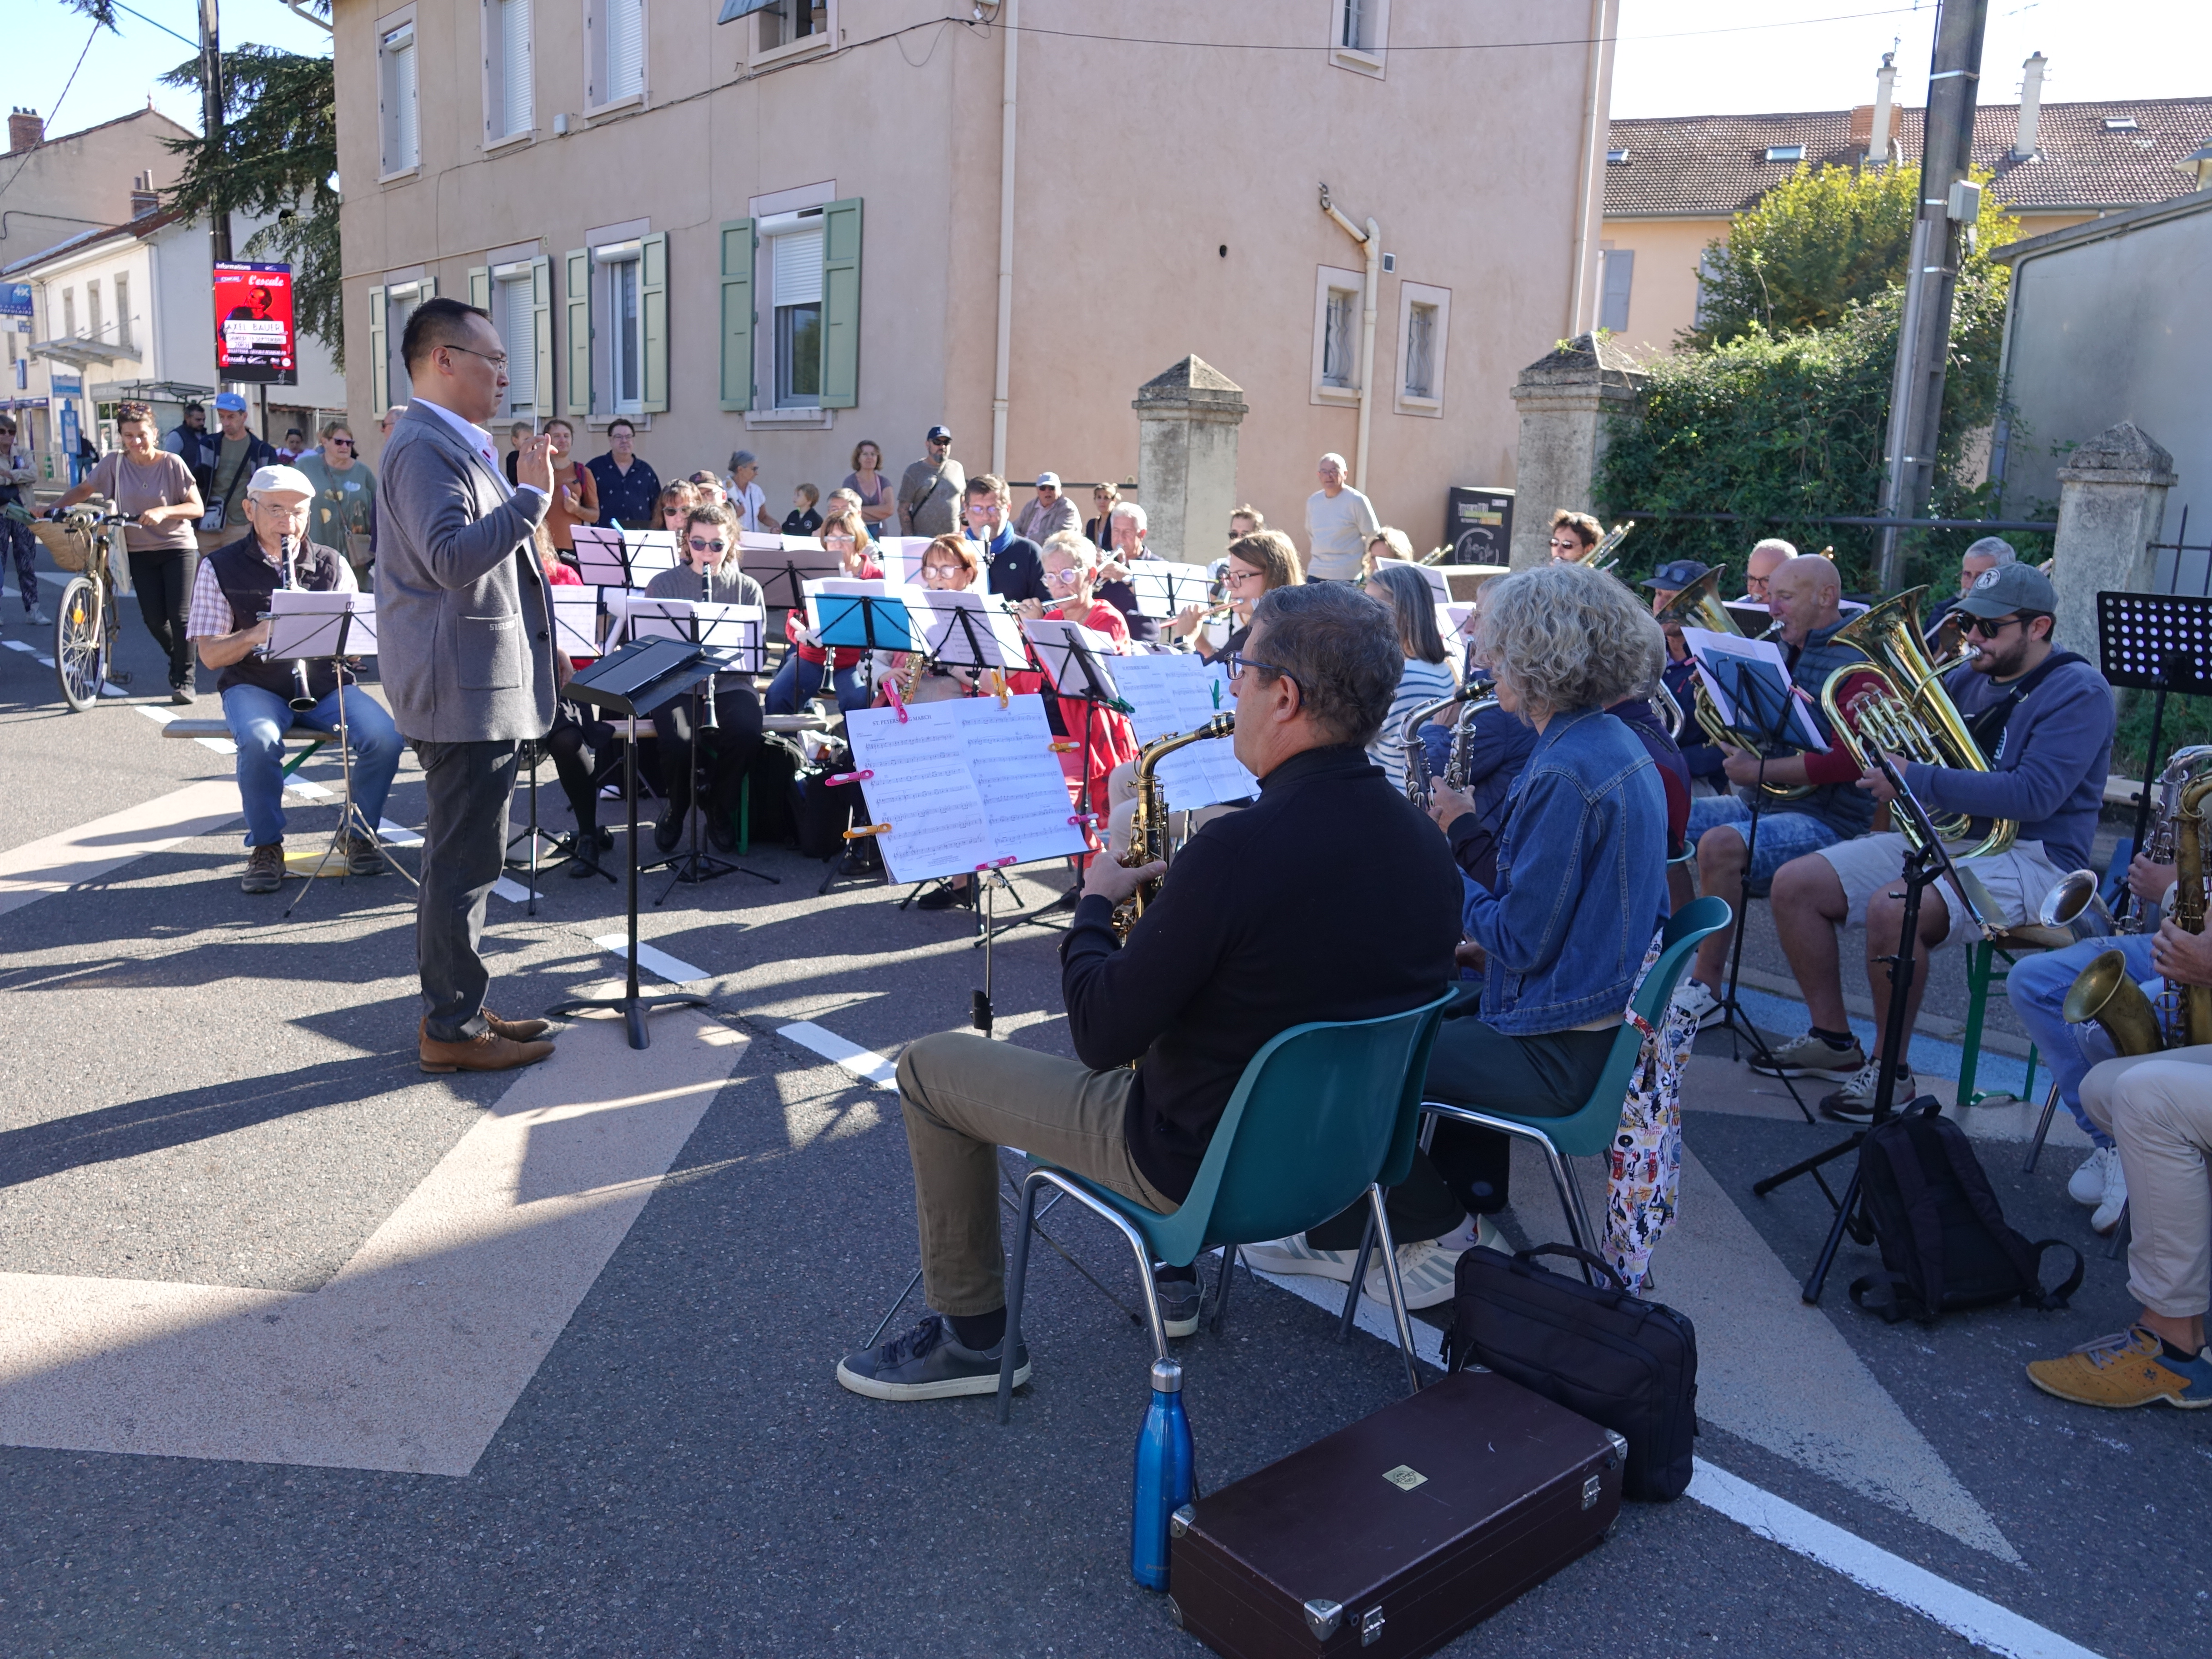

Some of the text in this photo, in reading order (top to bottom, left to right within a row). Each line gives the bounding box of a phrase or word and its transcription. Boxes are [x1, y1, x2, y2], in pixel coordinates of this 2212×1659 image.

[216, 262, 251, 271] Informations
[248, 275, 284, 287] l'escale
[253, 323, 281, 332] BAUER
[1393, 1471, 1417, 1484] SELMER
